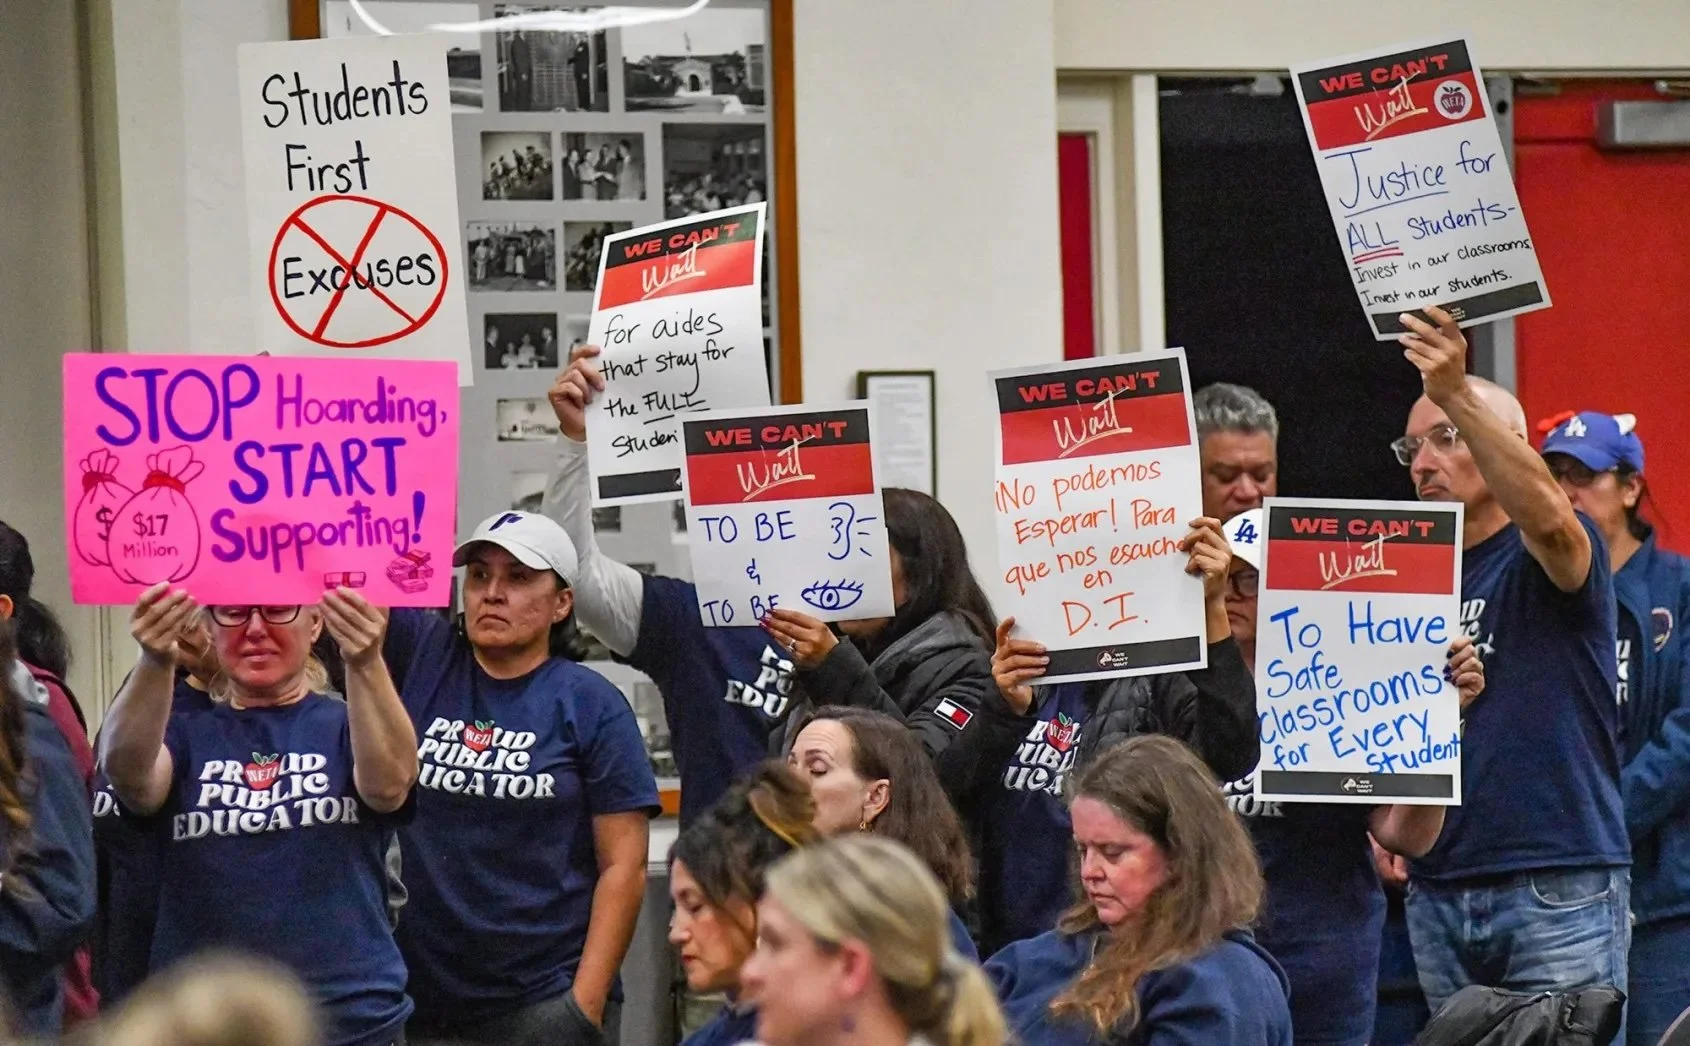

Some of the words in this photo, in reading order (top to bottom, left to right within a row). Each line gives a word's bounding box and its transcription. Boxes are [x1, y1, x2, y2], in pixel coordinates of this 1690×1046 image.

[262, 60, 428, 127] Students
[1320, 72, 1363, 93] WE
[1371, 54, 1448, 82] CAN'T
[1354, 71, 1421, 132] Wait
[286, 140, 370, 193] First
[1324, 147, 1446, 209] Justice
[1456, 140, 1496, 174] for
[624, 238, 663, 258] WE
[669, 223, 740, 248] CAN'T
[1346, 222, 1399, 254] ALL
[283, 251, 435, 299] Excuses
[642, 236, 712, 292] Wait
[1353, 263, 1398, 284] Invest
[1408, 261, 1421, 270] in
[1427, 252, 1450, 268] our
[1360, 290, 1401, 307] Invest
[1404, 289, 1416, 300] in
[1418, 284, 1440, 298] our
[604, 314, 642, 348] for
[652, 308, 723, 339] aides
[599, 354, 648, 382] that
[656, 351, 700, 397] stay
[702, 339, 734, 361] for
[1018, 382, 1066, 403] WE
[1076, 371, 1160, 396] CAN'T
[95, 363, 260, 447] STOP
[277, 373, 447, 438] Hoarding,
[603, 398, 638, 417] the
[642, 391, 706, 411] FULL
[1053, 386, 1130, 449] Wait
[611, 430, 678, 458] Studen
[705, 428, 752, 447] WE
[761, 421, 847, 442] CAN'T
[229, 437, 406, 504] START
[737, 435, 815, 493] Wait
[1053, 460, 1161, 511] podemos
[132, 511, 169, 538] $17
[211, 491, 425, 573] Supporting!
[699, 516, 738, 543] TO
[755, 510, 796, 541] BE
[1015, 498, 1118, 547] Esperar!
[1131, 498, 1176, 529] Para
[1234, 518, 1258, 544] LA
[1290, 517, 1338, 534] WE
[1347, 518, 1435, 537] CAN'T
[123, 541, 178, 558] Million
[1005, 559, 1050, 596] que
[1057, 544, 1098, 574] nos
[1319, 531, 1401, 582] Wait
[1084, 568, 1113, 590] en
[703, 600, 734, 626] TO
[1270, 606, 1322, 653] To
[1348, 601, 1448, 645] Have
[1267, 650, 1343, 698] Safe
[417, 738, 531, 772] PUBLIC
[1273, 740, 1310, 771] for
[1329, 709, 1429, 758] Every
[196, 772, 330, 811] PUBLIC
[173, 797, 360, 841] EDUCATOR
